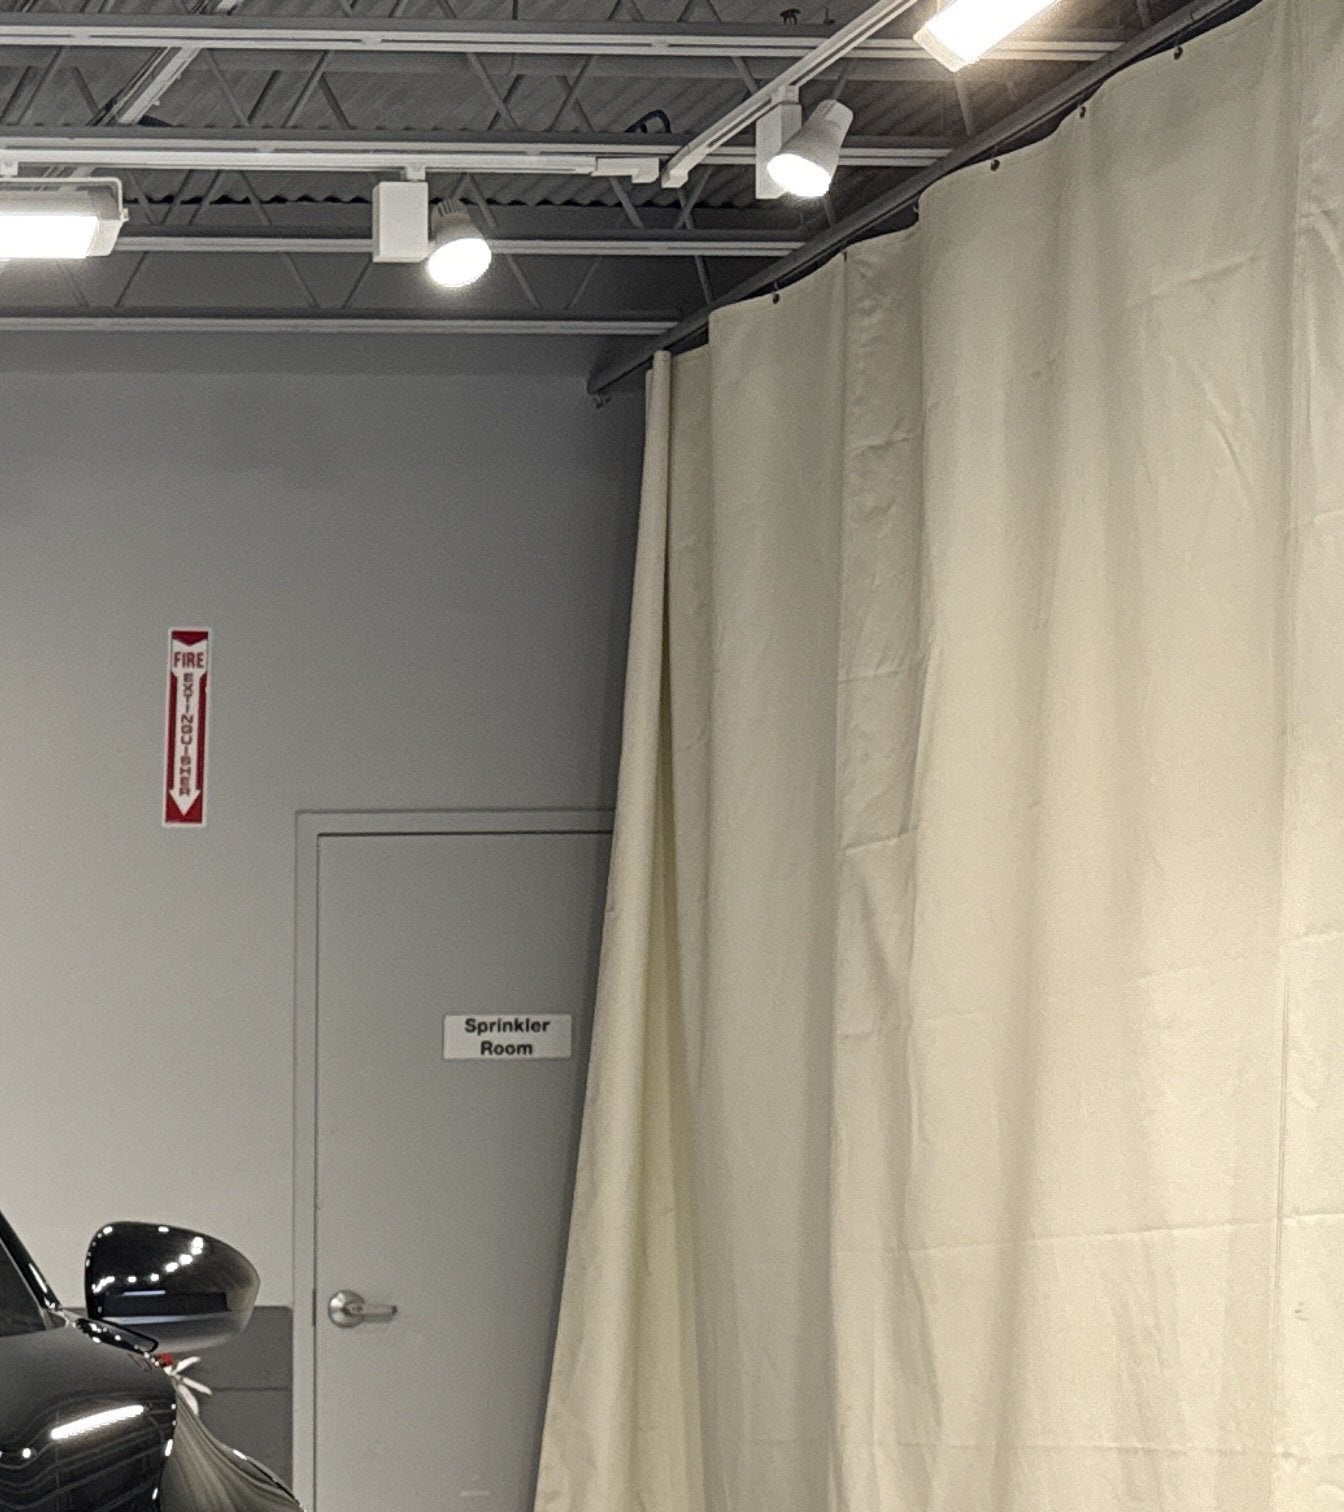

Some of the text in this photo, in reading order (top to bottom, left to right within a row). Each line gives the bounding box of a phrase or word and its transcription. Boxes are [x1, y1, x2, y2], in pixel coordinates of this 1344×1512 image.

[173, 652, 205, 668] FIRE
[464, 1018, 551, 1035] Sprinkler
[480, 1040, 533, 1055] Room
